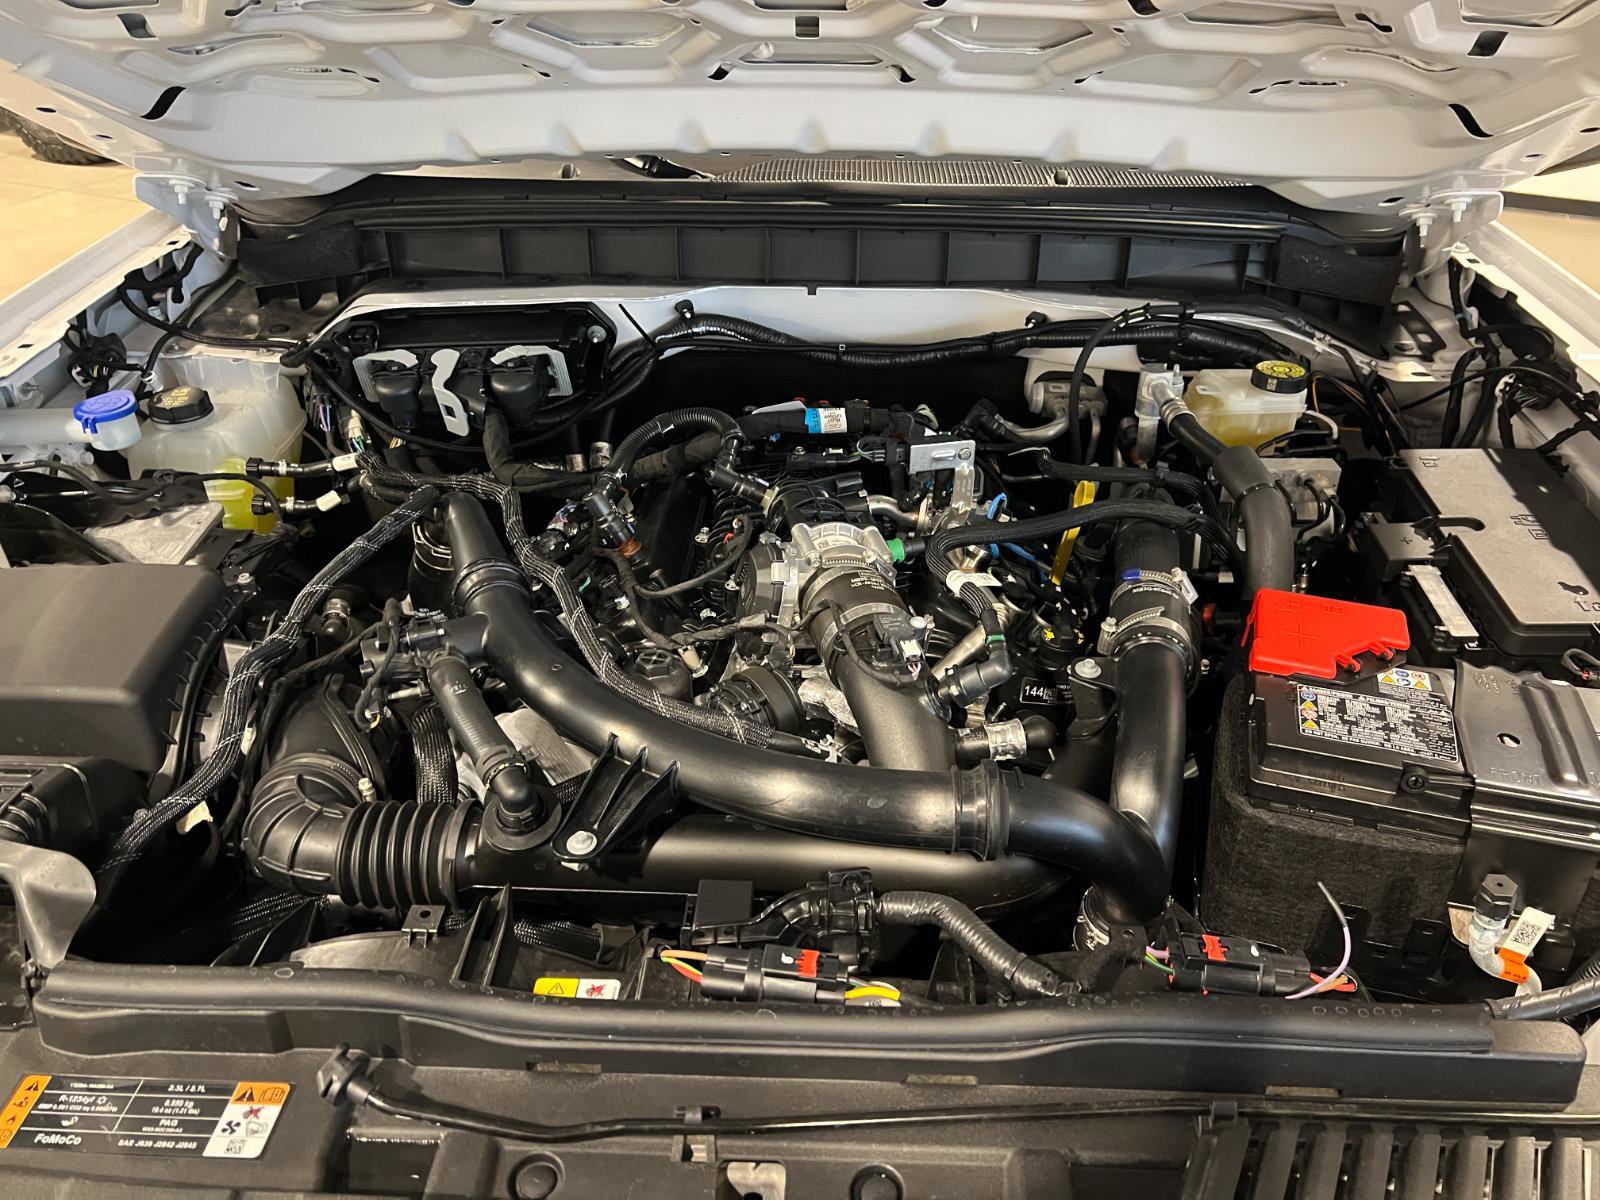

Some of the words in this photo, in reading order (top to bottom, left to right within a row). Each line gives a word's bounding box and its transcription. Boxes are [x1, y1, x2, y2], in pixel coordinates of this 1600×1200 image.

[1024, 685, 1044, 697] 144
[59, 1094, 95, 1104] R-1234yf
[184, 1100, 194, 1109] kg
[34, 1133, 82, 1145] FoMoCo
